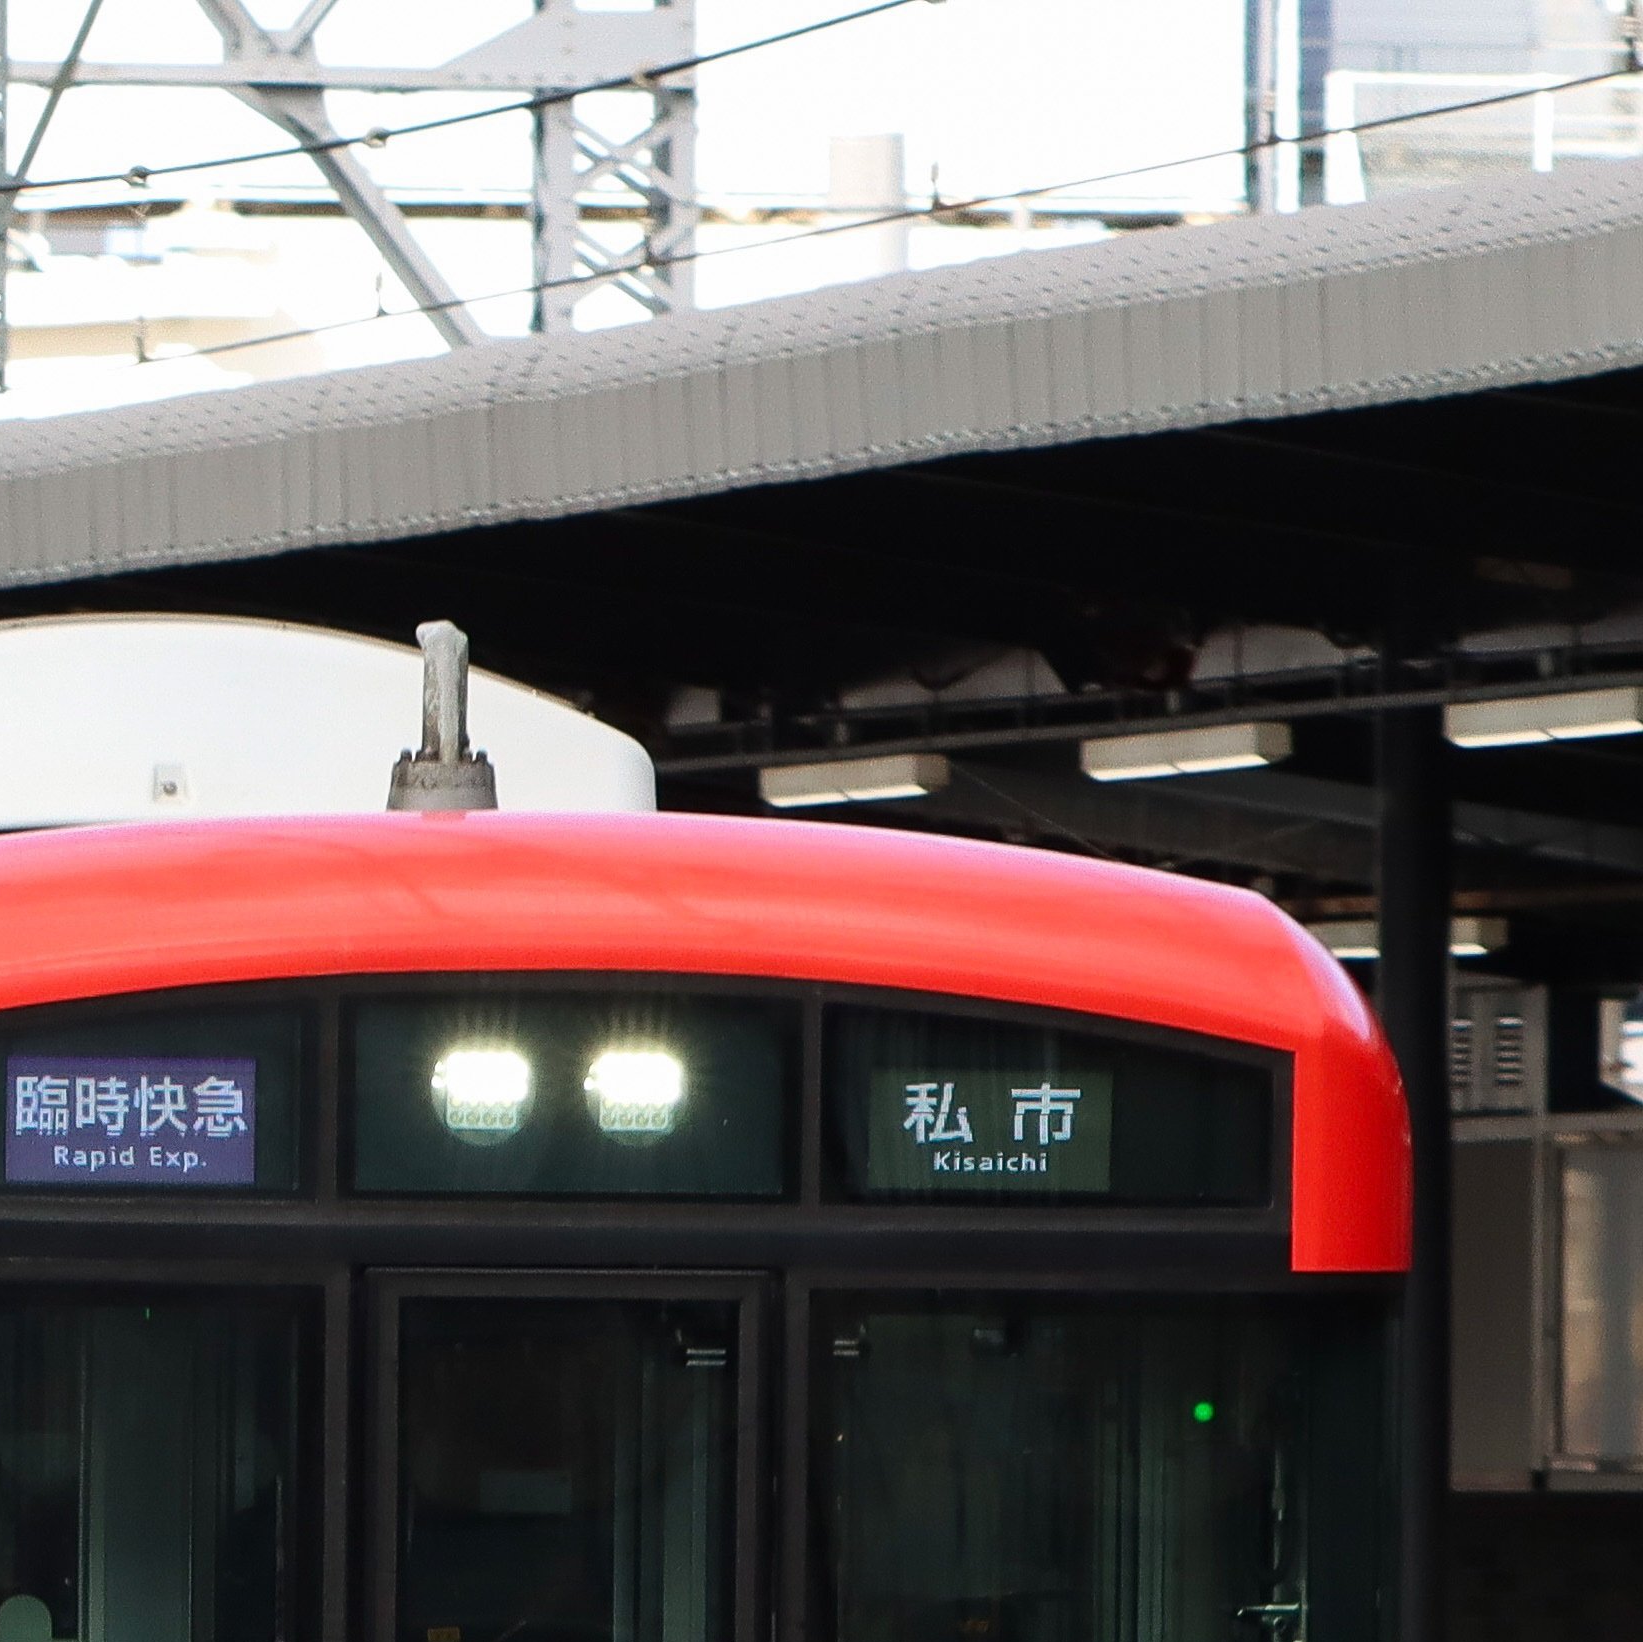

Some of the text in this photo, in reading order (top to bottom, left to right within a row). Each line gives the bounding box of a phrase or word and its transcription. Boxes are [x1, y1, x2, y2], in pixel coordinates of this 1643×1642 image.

[15, 1075, 248, 1137] 臨時快急
[53, 1146, 207, 1172] Rapid Exp.
[933, 1151, 1048, 1172] Kisaichi
